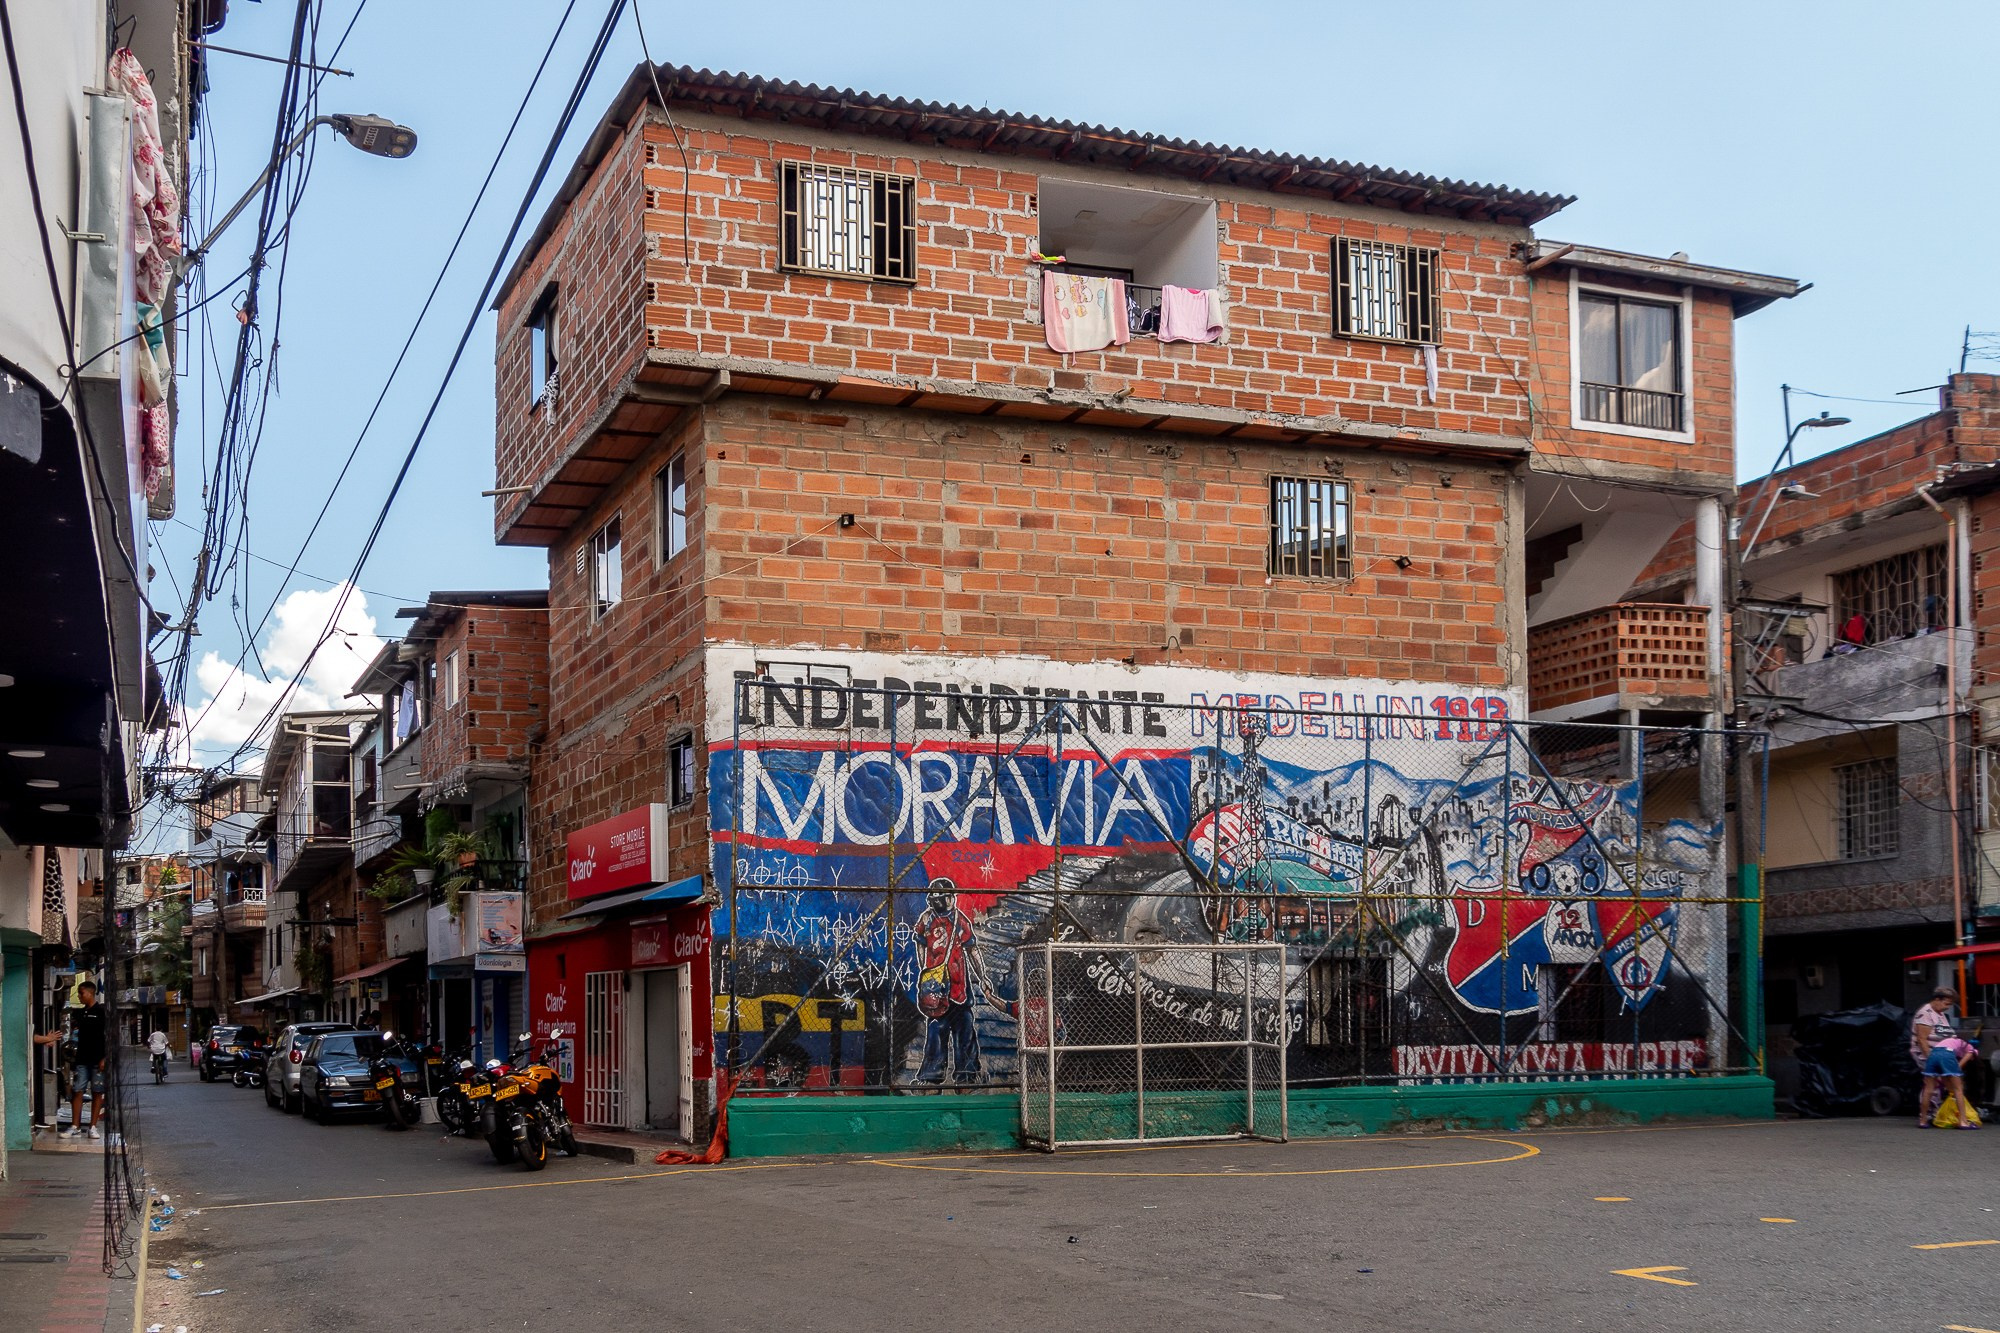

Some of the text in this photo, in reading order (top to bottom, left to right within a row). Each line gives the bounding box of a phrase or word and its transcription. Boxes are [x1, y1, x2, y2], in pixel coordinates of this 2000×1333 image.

[733, 669, 1511, 743] INDEPENDIENTE MEDELLIN 1913
[742, 749, 1173, 846] MORAVIA
[610, 826, 645, 848] STORE MOBILE
[571, 855, 593, 882] Claro
[1555, 909, 1583, 929] 12
[675, 930, 703, 957] Claro
[545, 990, 564, 1012] Claro
[537, 1019, 544, 1034] #1
[544, 1023, 551, 1034] en
[1193, 1001, 1213, 1027] de
[1220, 1005, 1242, 1032] mi
